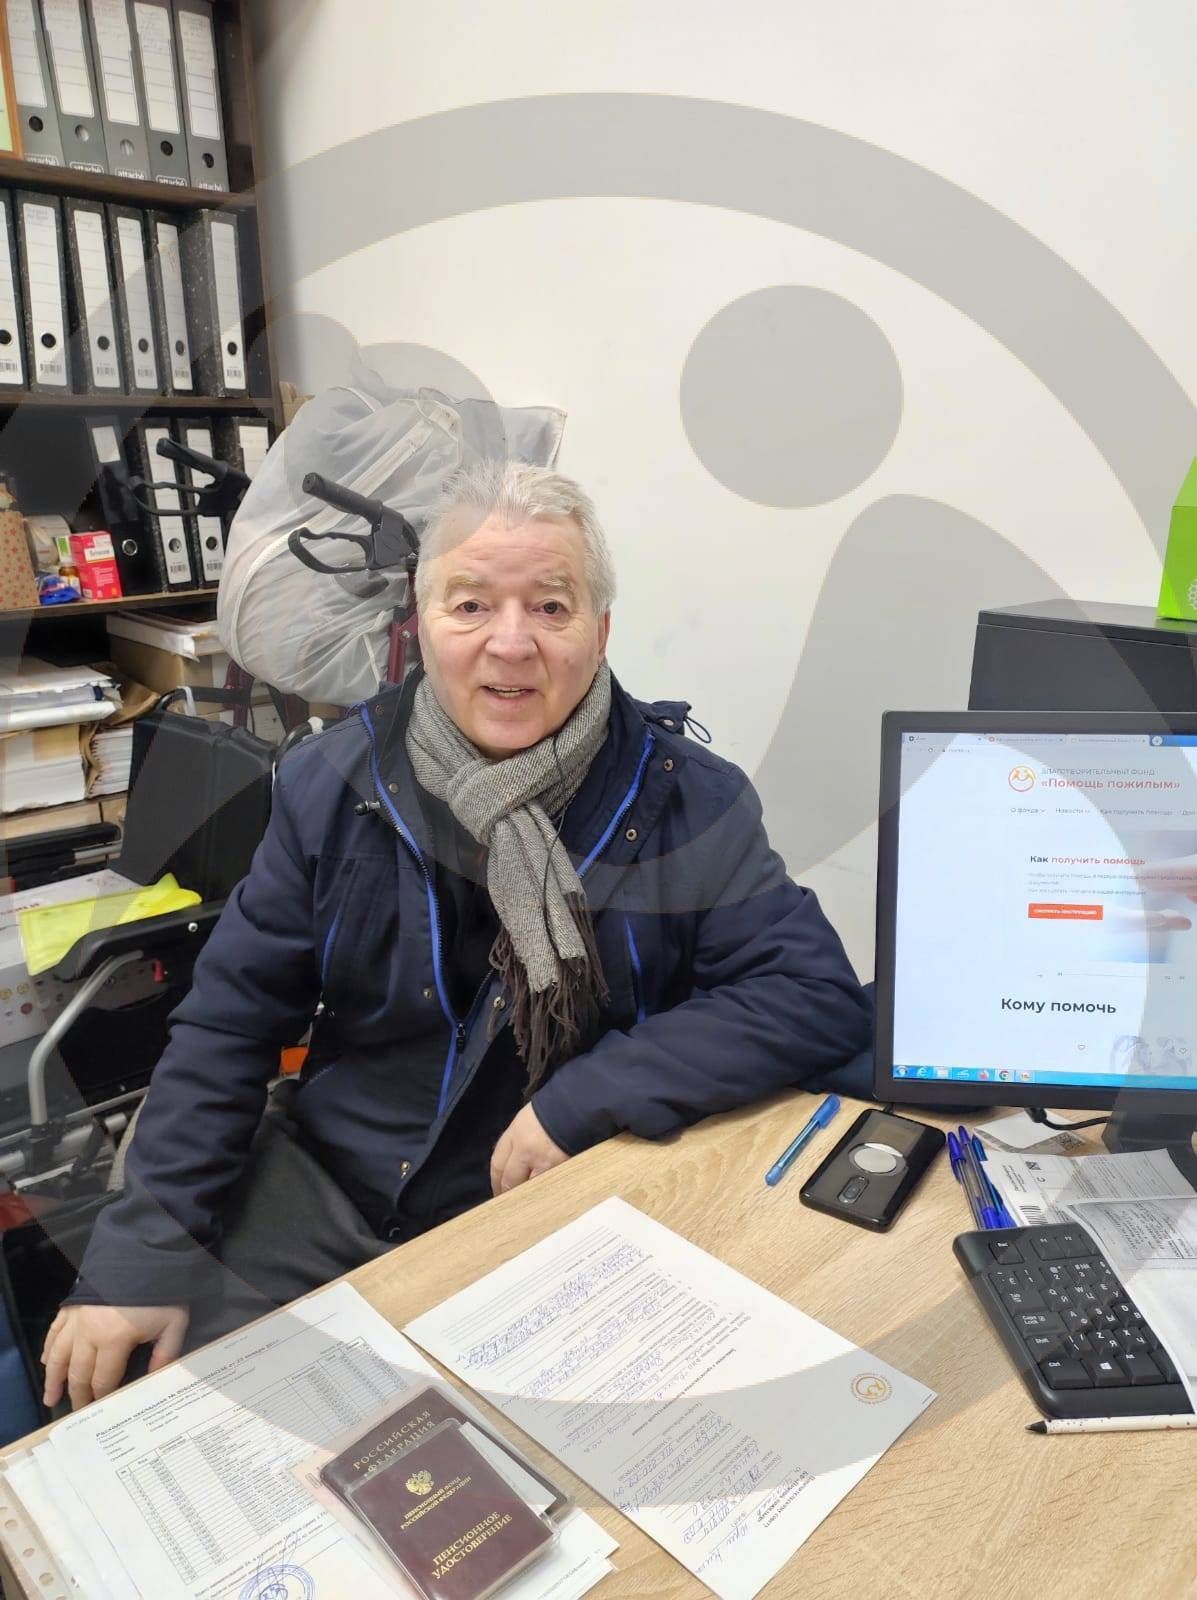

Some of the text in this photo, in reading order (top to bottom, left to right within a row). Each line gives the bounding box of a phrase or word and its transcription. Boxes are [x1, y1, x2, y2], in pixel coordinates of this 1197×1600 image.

[1130, 768, 1155, 776] ФОНД
[1041, 778, 1180, 790] «Помощь пожилым»
[1030, 855, 1049, 863] Как
[1051, 857, 1100, 865] получить
[1001, 998, 1117, 1014] Кому помочь
[351, 1409, 431, 1469] РОССИЙСКАЯ
[400, 1499, 439, 1529] РОССИЙСКОЙ
[431, 1513, 513, 1578] УДОСТОВЕРЕНИЕ
[432, 1511, 500, 1565] ПЕНСИОННОЕ
